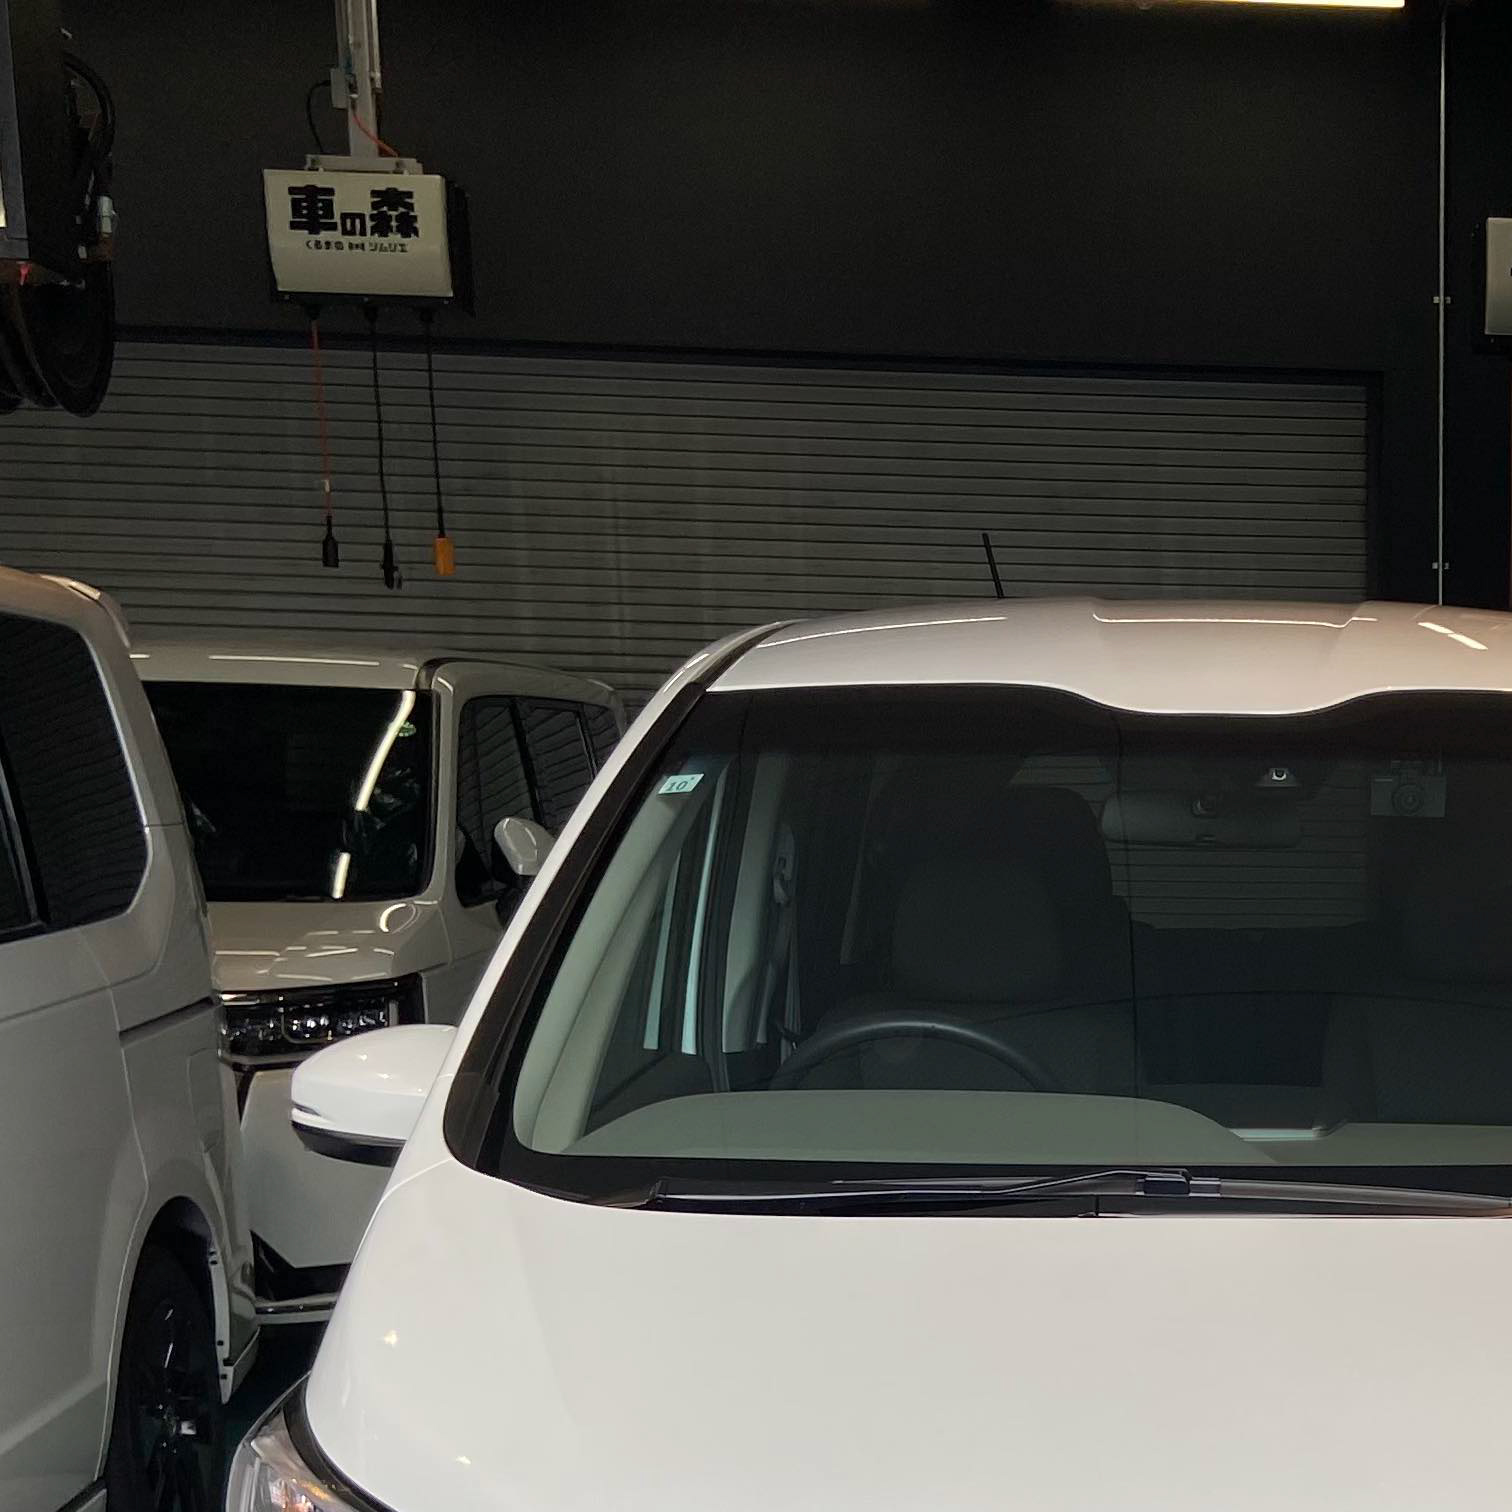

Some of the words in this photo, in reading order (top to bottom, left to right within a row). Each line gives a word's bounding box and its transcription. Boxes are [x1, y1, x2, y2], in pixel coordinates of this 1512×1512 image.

[288, 184, 419, 238] 車の森
[306, 240, 344, 250] くるまの
